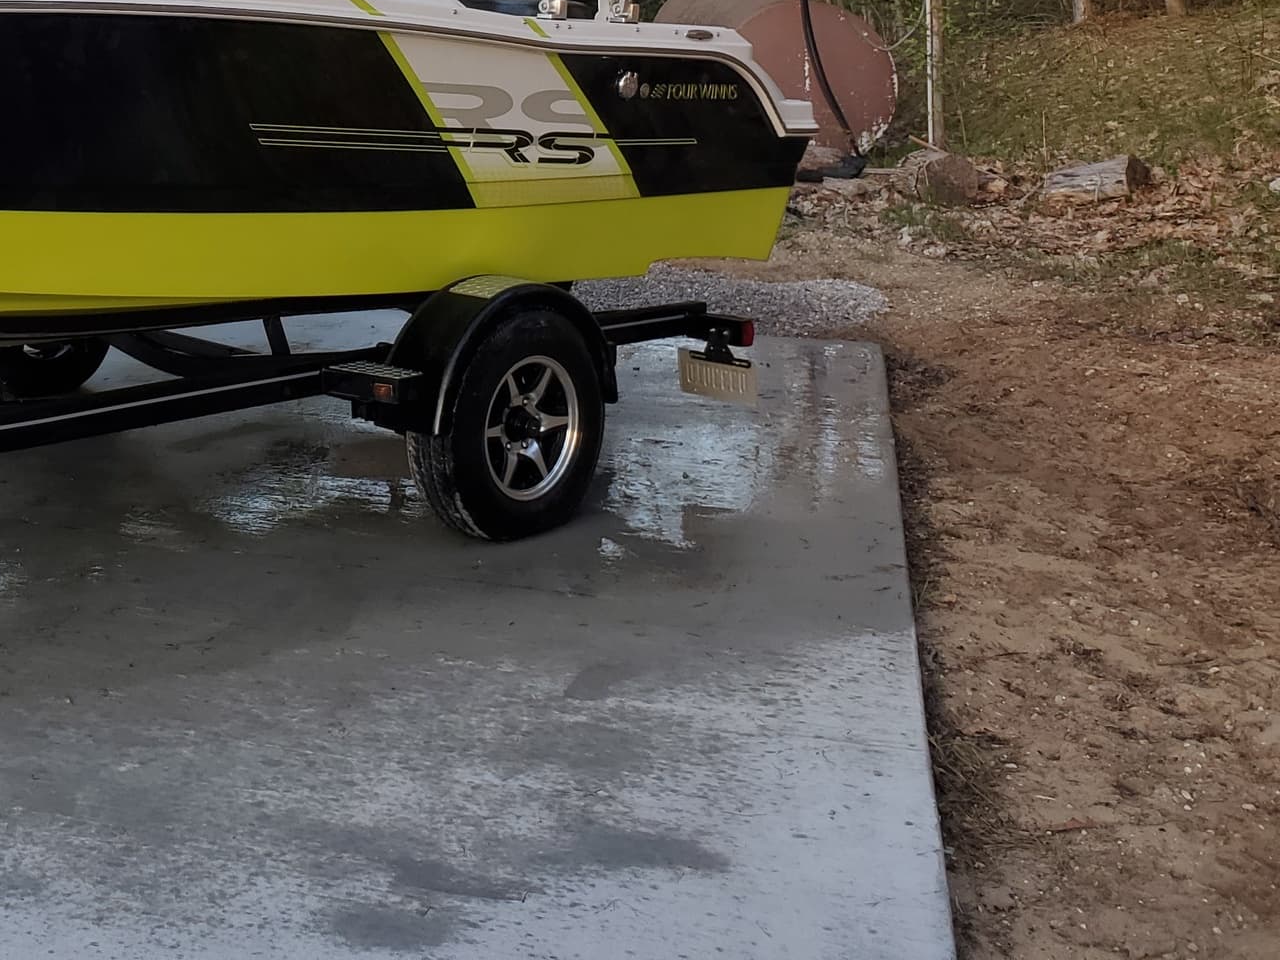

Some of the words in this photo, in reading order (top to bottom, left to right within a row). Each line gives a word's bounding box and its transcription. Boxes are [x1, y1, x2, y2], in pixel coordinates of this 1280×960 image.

[666, 83, 698, 100] FOUR
[699, 84, 738, 100] WINNS
[470, 126, 596, 168] RS
